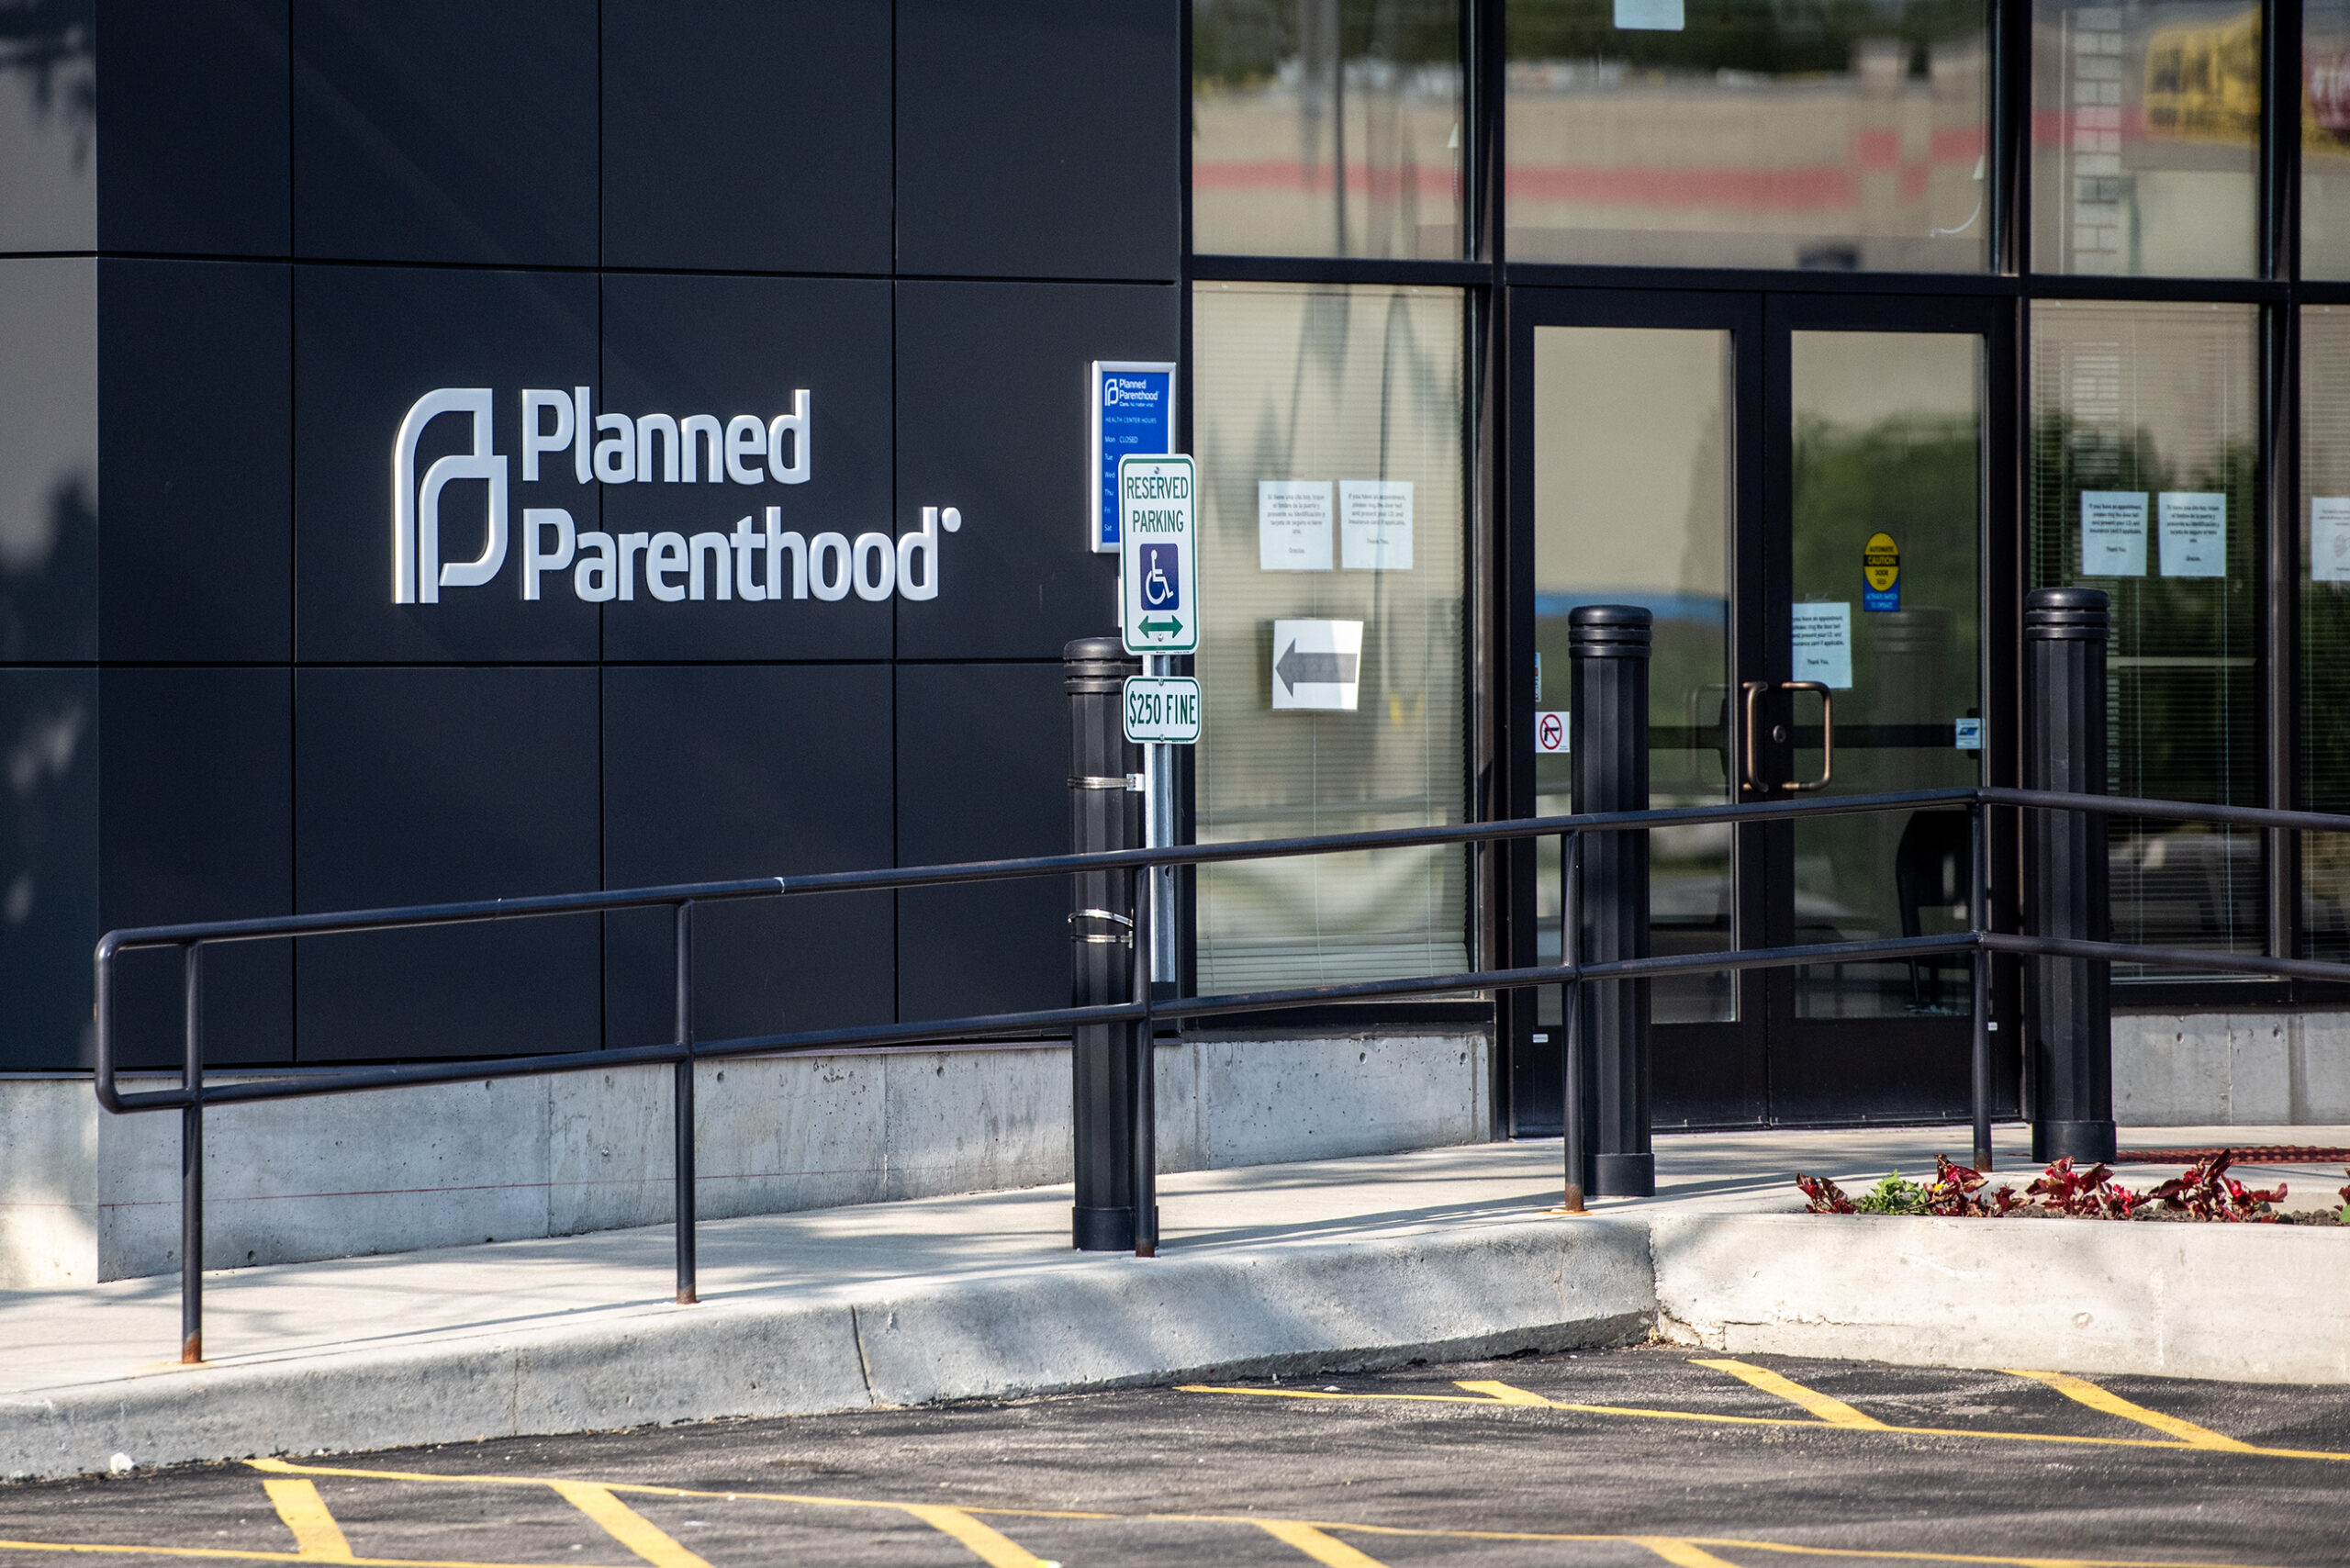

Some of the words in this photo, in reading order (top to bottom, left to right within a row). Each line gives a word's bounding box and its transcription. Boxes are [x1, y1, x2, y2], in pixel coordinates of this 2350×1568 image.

[1120, 378, 1146, 389] Planned
[1120, 389, 1158, 400] Parenthood
[522, 386, 811, 484] Planned
[1127, 477, 1188, 498] RESERVED
[1133, 510, 1183, 532] PARKING
[523, 507, 938, 602] Parenthood
[1130, 691, 1161, 727] $250
[1167, 695, 1196, 724] FINE
